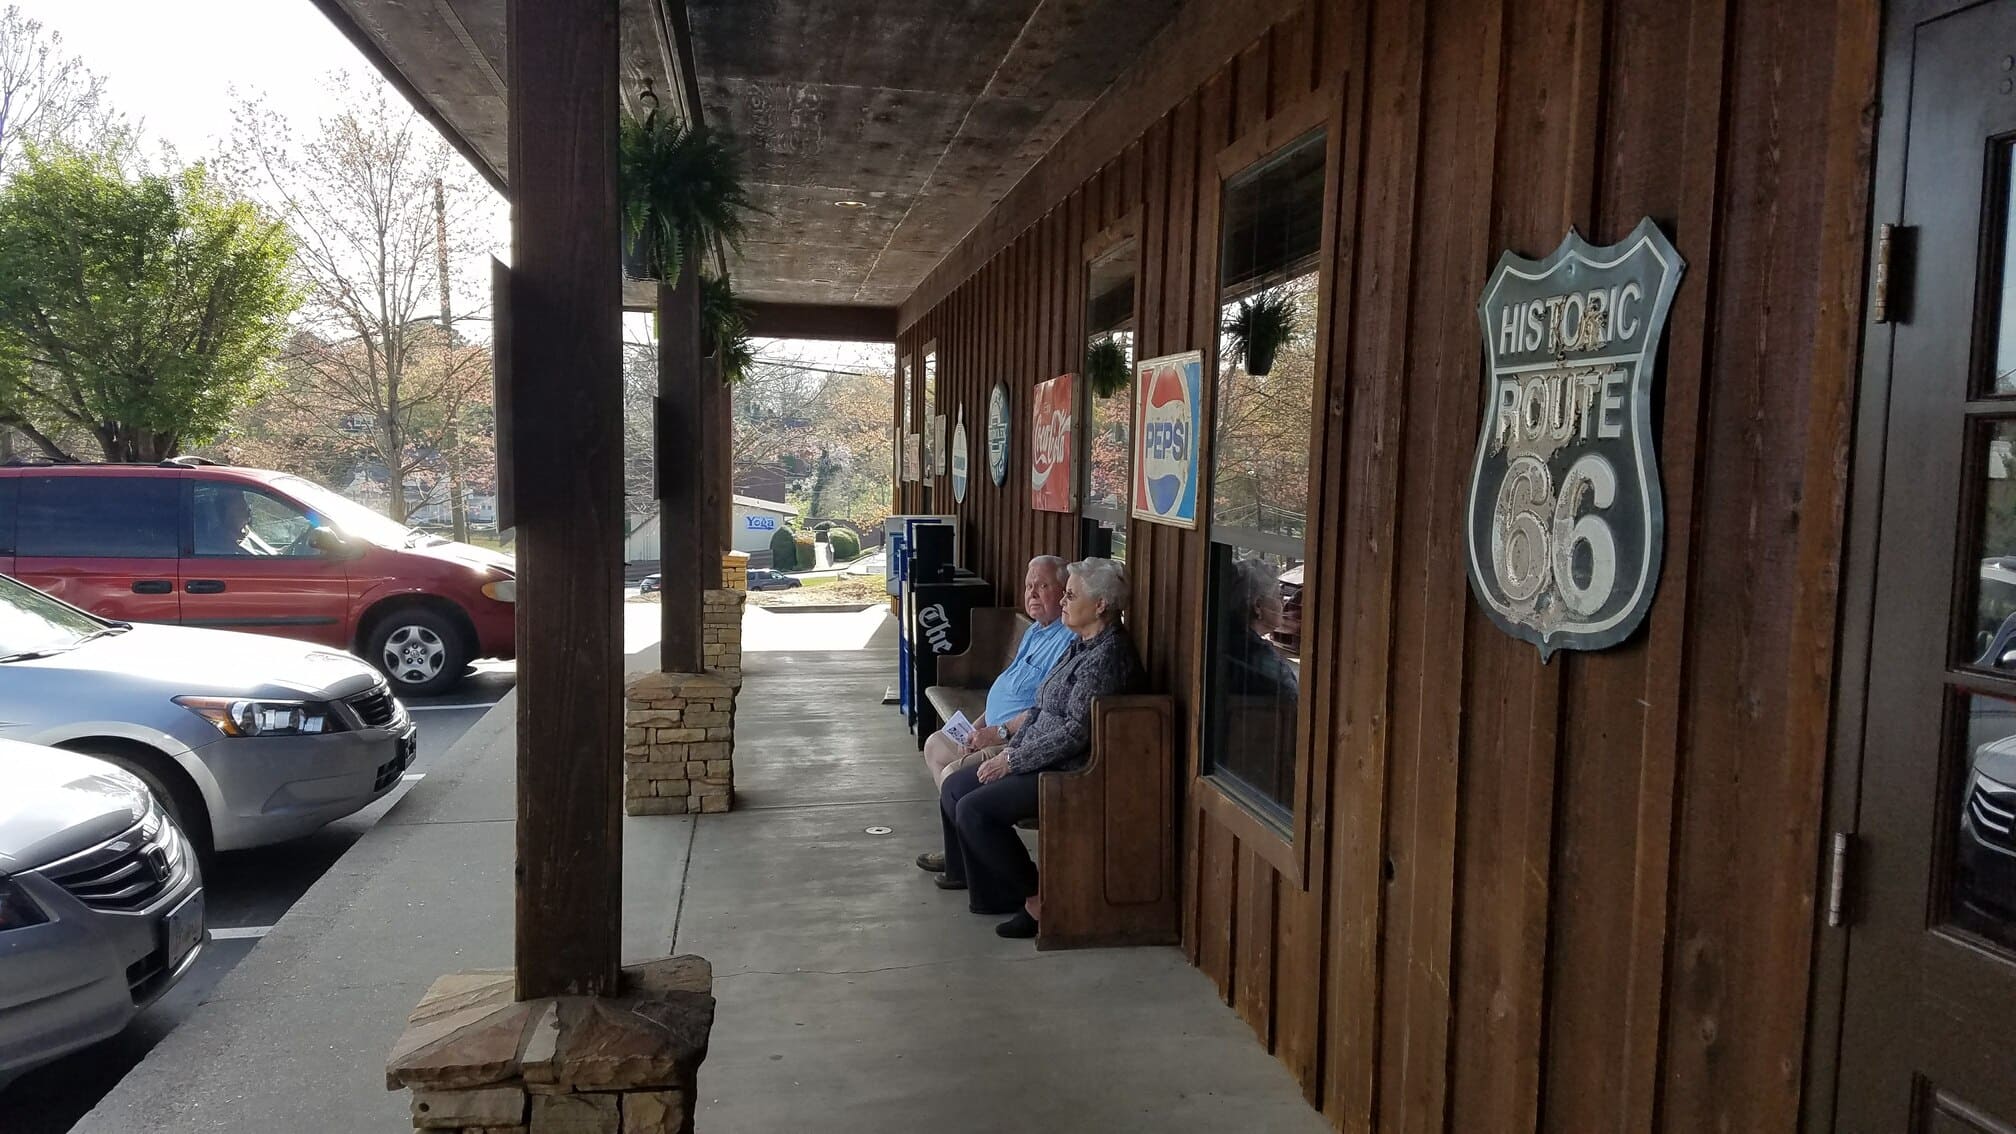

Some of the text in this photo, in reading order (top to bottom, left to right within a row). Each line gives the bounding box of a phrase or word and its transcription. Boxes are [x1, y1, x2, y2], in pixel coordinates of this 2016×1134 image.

[1500, 282, 1642, 356] HISTORIC
[1496, 368, 1627, 443] ROUTE
[1145, 421, 1189, 461] PEPSI
[746, 516, 775, 529] Yoga
[1492, 453, 1616, 616] 66
[918, 603, 953, 654] The
